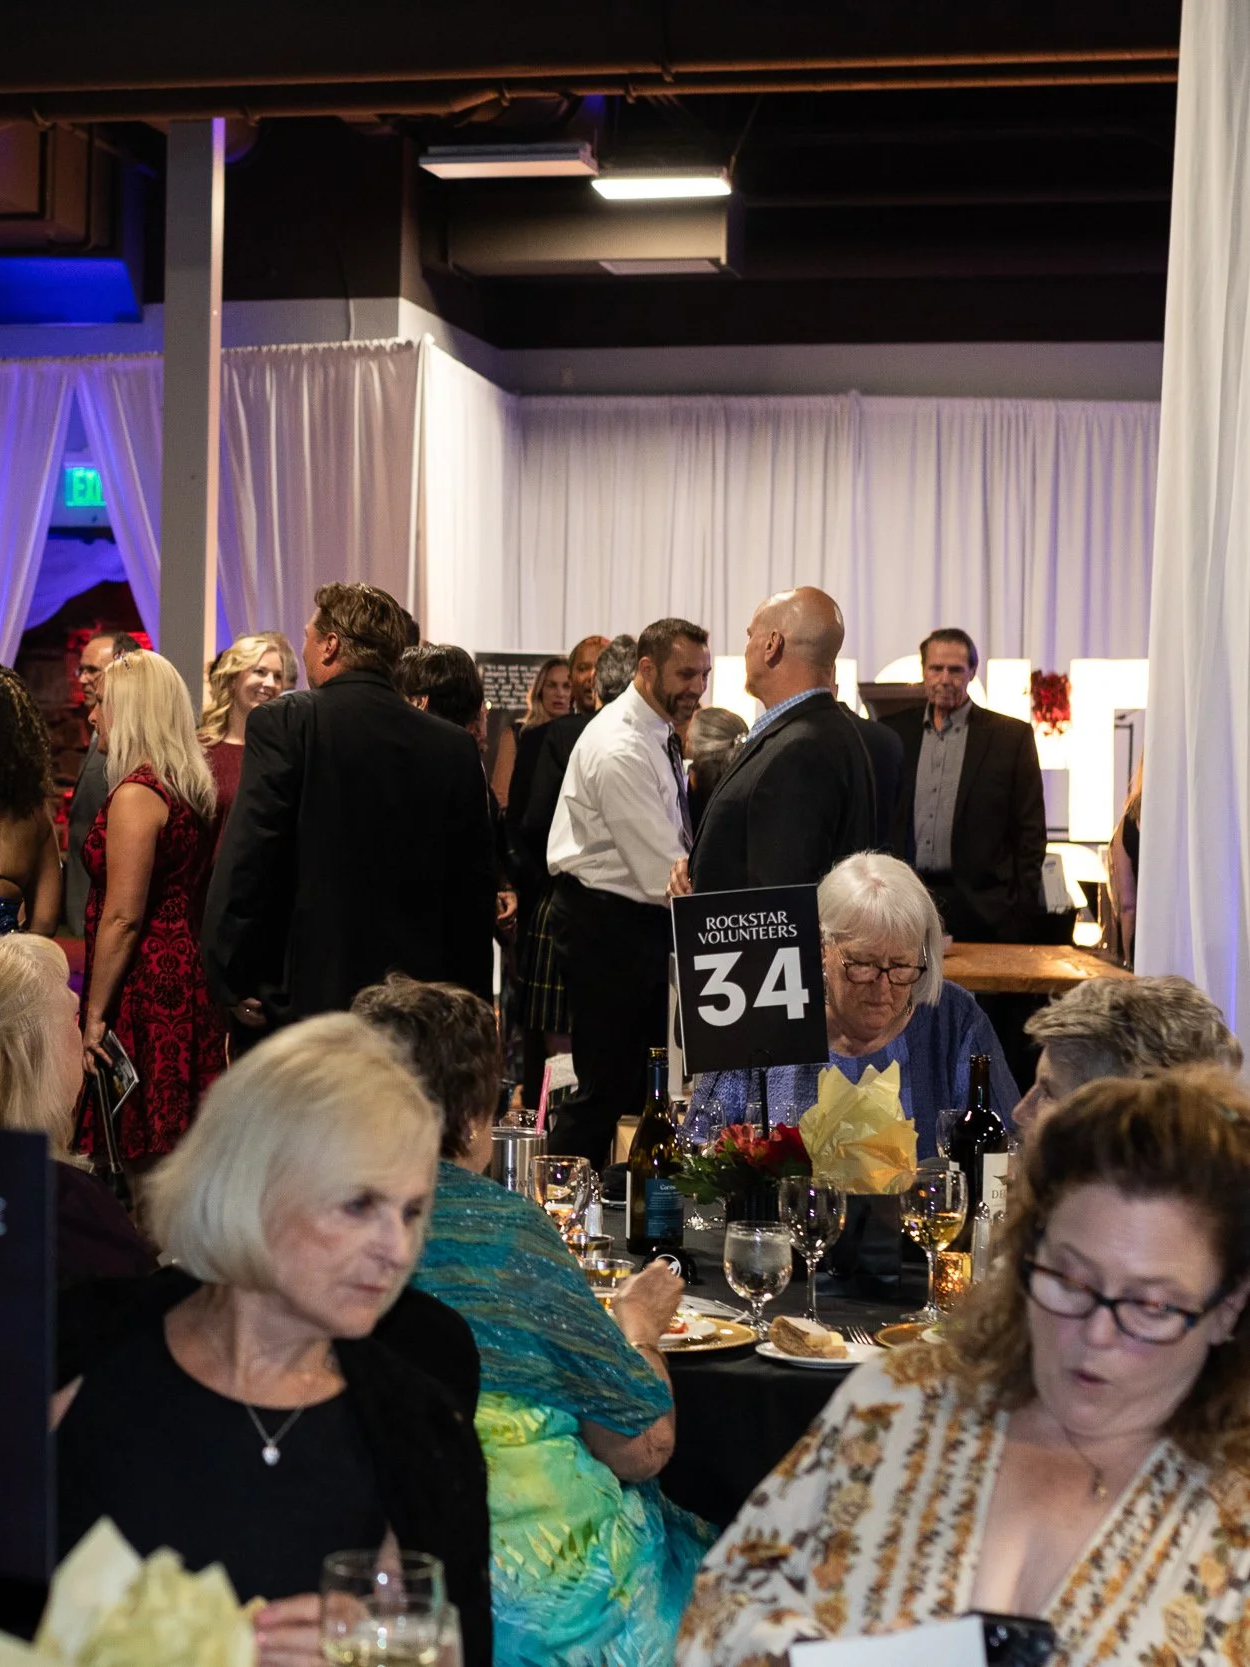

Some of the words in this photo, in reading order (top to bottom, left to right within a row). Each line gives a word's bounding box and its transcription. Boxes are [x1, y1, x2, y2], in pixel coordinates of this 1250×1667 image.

[706, 911, 788, 930] ROCKSTAR
[698, 924, 798, 944] VOLUNTEERS
[693, 946, 810, 1027] 34
